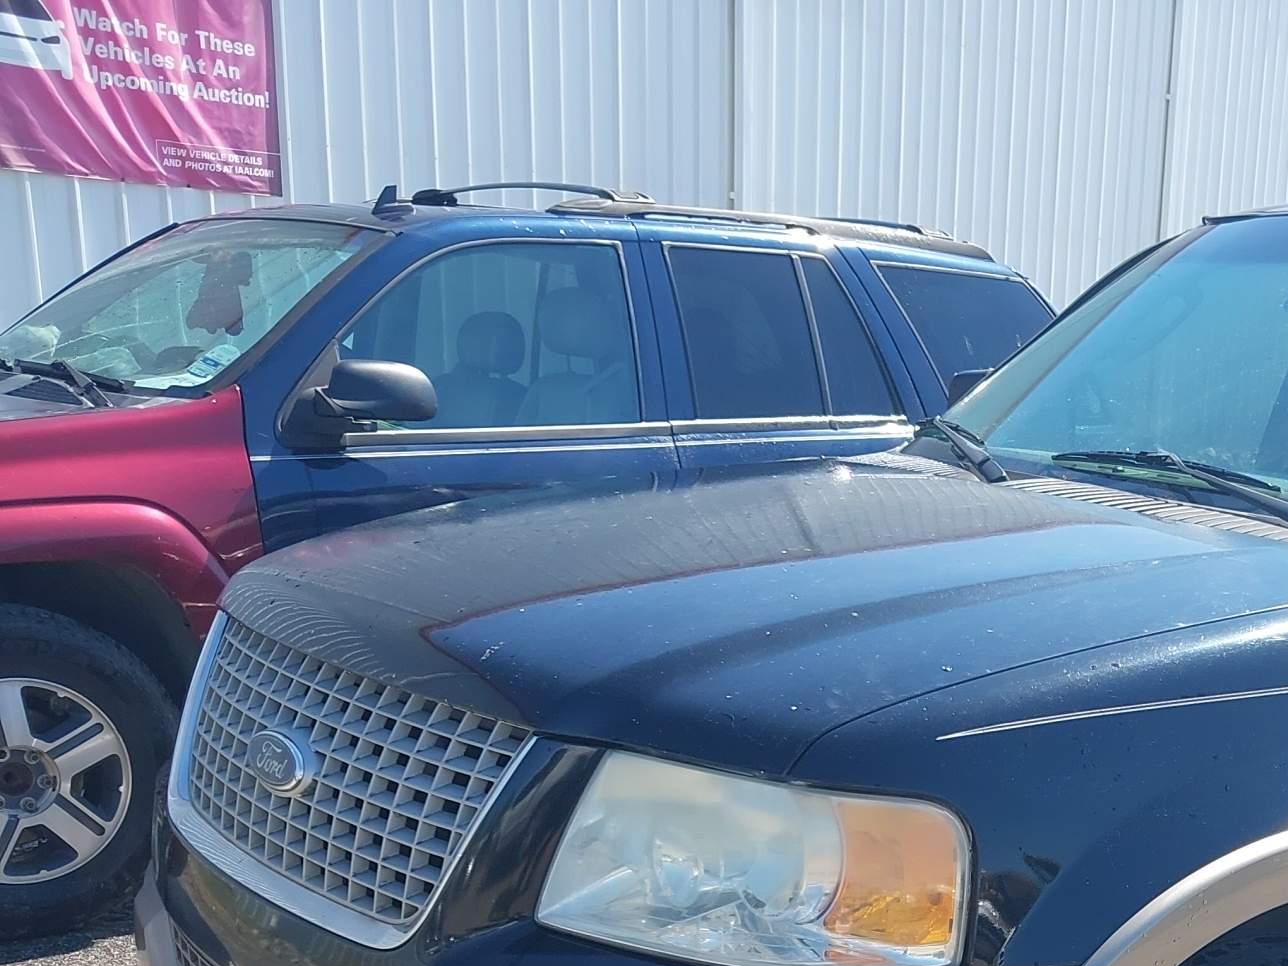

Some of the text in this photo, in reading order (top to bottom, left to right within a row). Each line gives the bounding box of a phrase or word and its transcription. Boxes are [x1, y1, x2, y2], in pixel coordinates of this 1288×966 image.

[73, 7, 255, 57] Watch For These
[79, 36, 241, 81] Vehicles At An
[82, 64, 270, 109] Upcoming Auction!
[161, 146, 263, 166] VIEW VEHICLE DETAILS
[162, 157, 182, 168] AND
[185, 160, 222, 173] PHOTOS
[222, 163, 234, 174] AT
[256, 741, 288, 778] Ford
